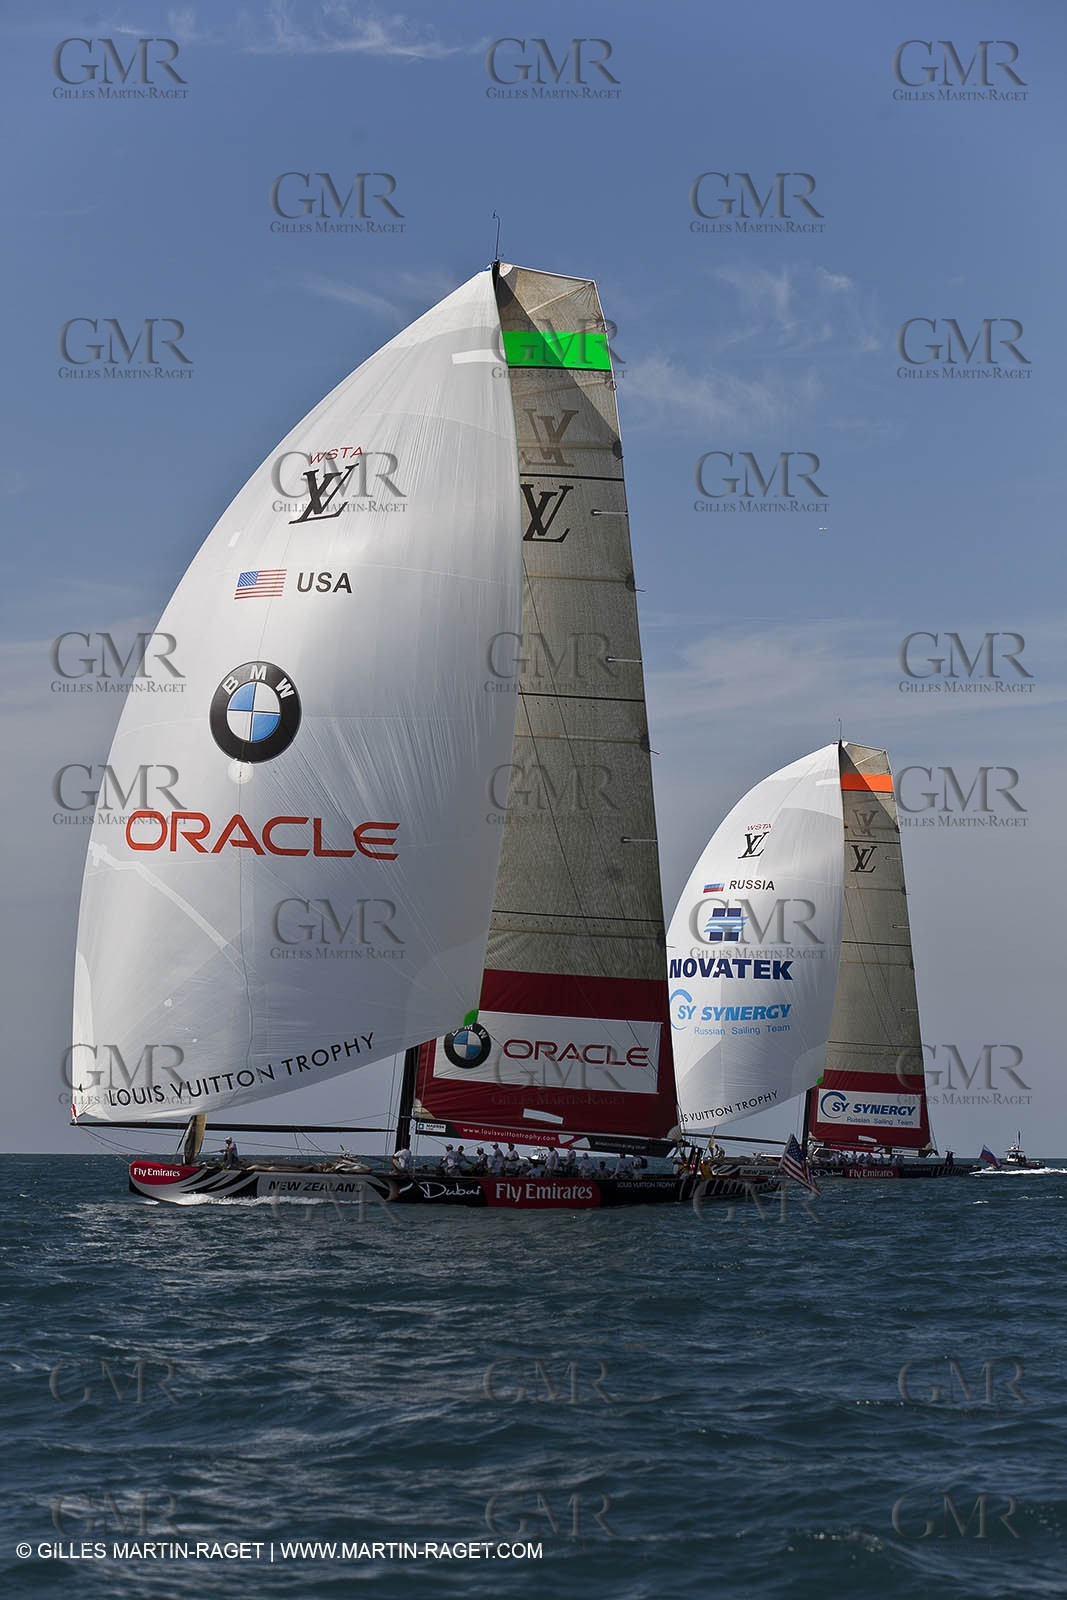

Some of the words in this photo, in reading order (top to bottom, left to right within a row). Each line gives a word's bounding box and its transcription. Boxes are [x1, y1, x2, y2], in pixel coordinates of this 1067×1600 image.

[309, 446, 364, 464] WSTA
[296, 571, 353, 594] USA
[221, 664, 295, 700] BMW
[125, 810, 401, 861] ORACLE
[729, 880, 775, 891] RUSSIA
[669, 958, 793, 980] NOVATEK
[701, 1004, 792, 1021] SYNERGY
[694, 1026, 726, 1035] Russian
[731, 1026, 761, 1036] Sailing
[767, 1024, 791, 1033] Team
[503, 1039, 650, 1067] ORACLE
[108, 1085, 165, 1106] LOUIS
[170, 1064, 275, 1099] VUITTON
[281, 1032, 375, 1076] TROPHY
[689, 1105, 733, 1120] VUITTON
[735, 1090, 778, 1111] TROPHY
[853, 1103, 916, 1116] SYNERGY
[463, 1127, 556, 1141] www.louisvuittontrophy.com
[133, 1167, 147, 1177] Fly
[148, 1168, 181, 1177] Emirates
[269, 1181, 301, 1191] NEW
[417, 1182, 482, 1198] Dubai
[495, 1183, 522, 1202] Fly
[526, 1183, 593, 1200] Emirates
